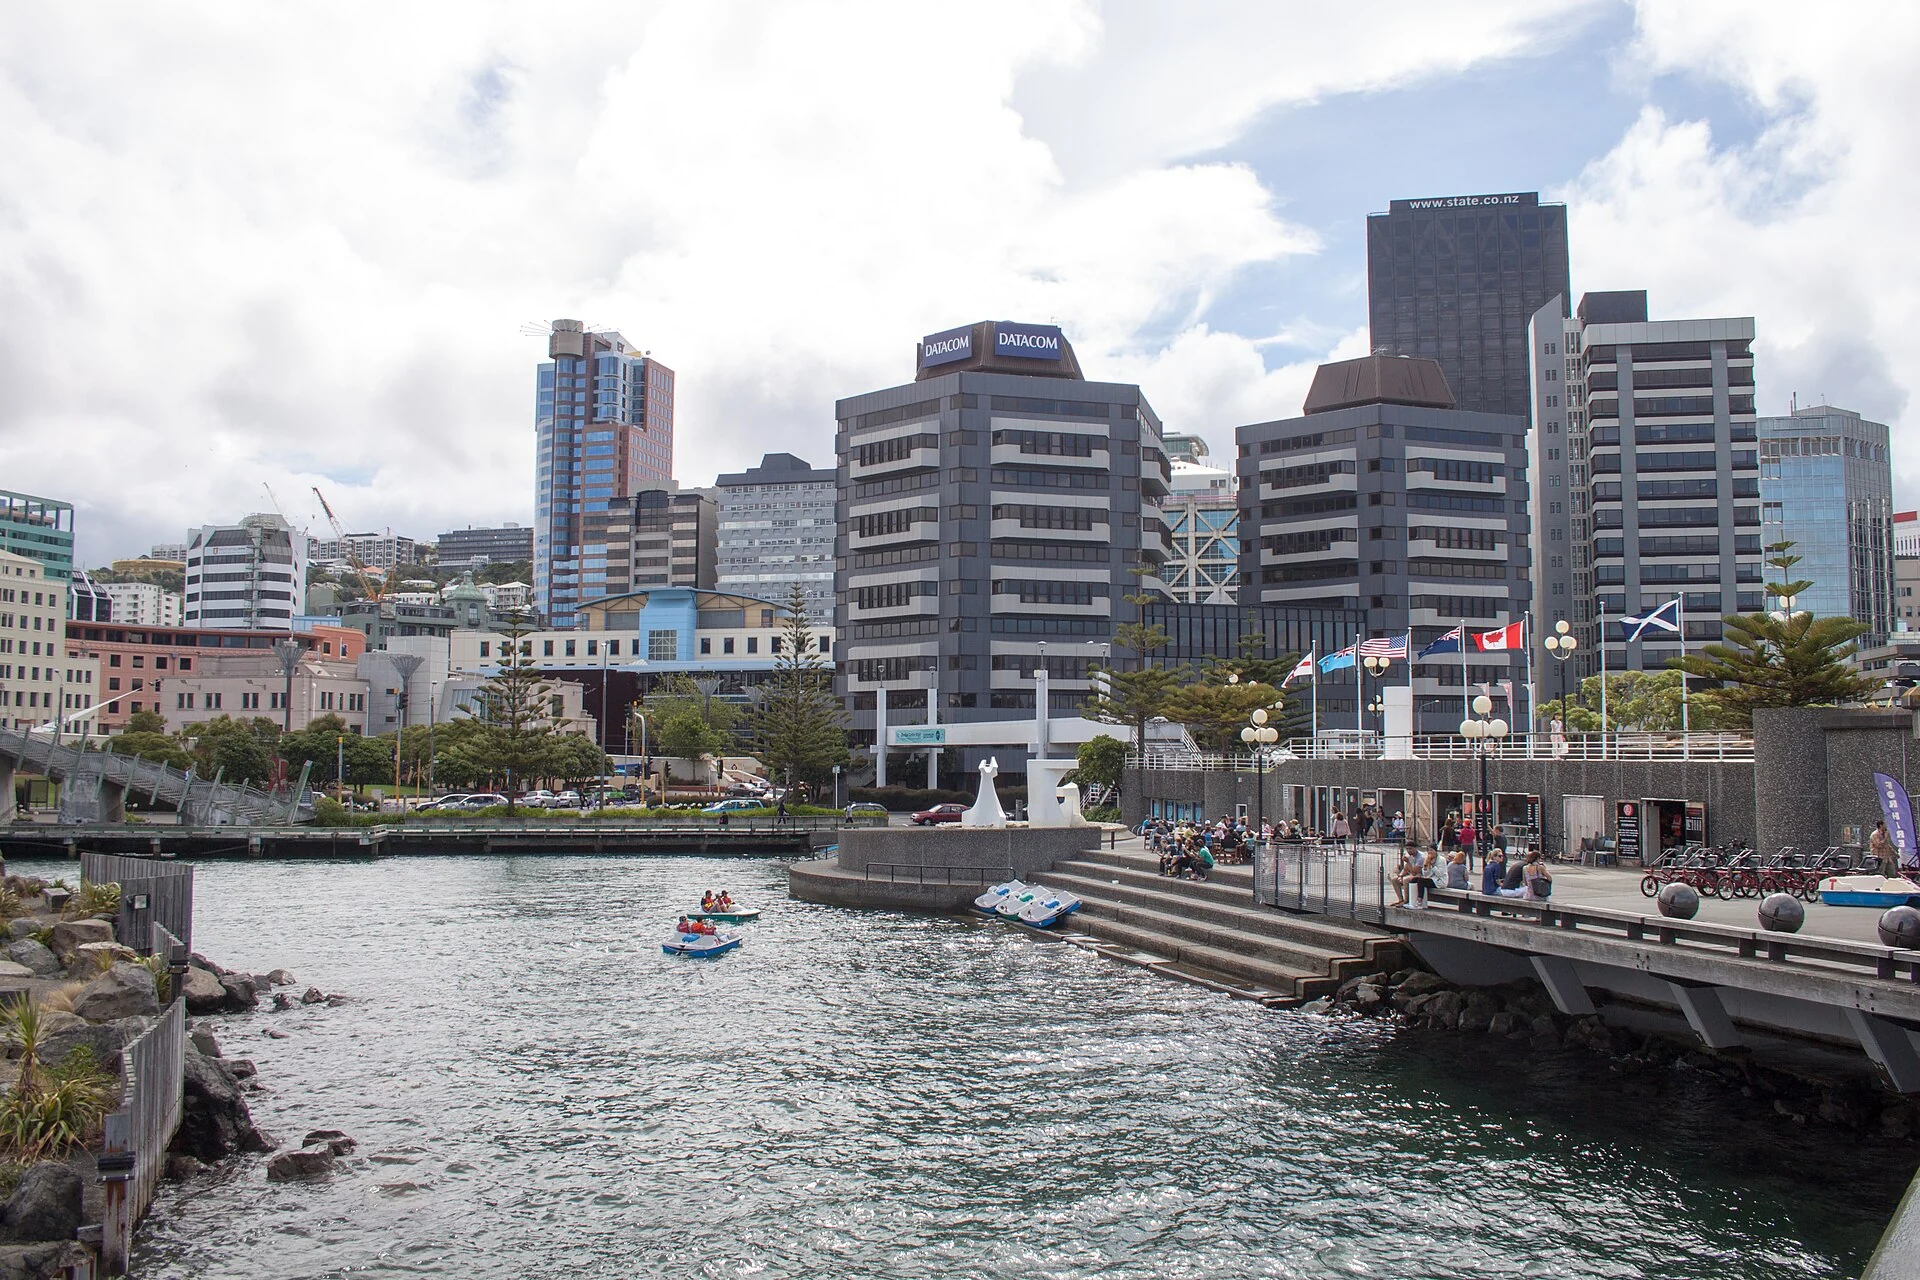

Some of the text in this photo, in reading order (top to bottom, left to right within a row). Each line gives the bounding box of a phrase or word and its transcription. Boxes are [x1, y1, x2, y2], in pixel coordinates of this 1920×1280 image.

[1409, 195, 1519, 209] www.state.co.nz
[925, 335, 969, 357] DATACOM
[999, 332, 1058, 349] DATACOM
